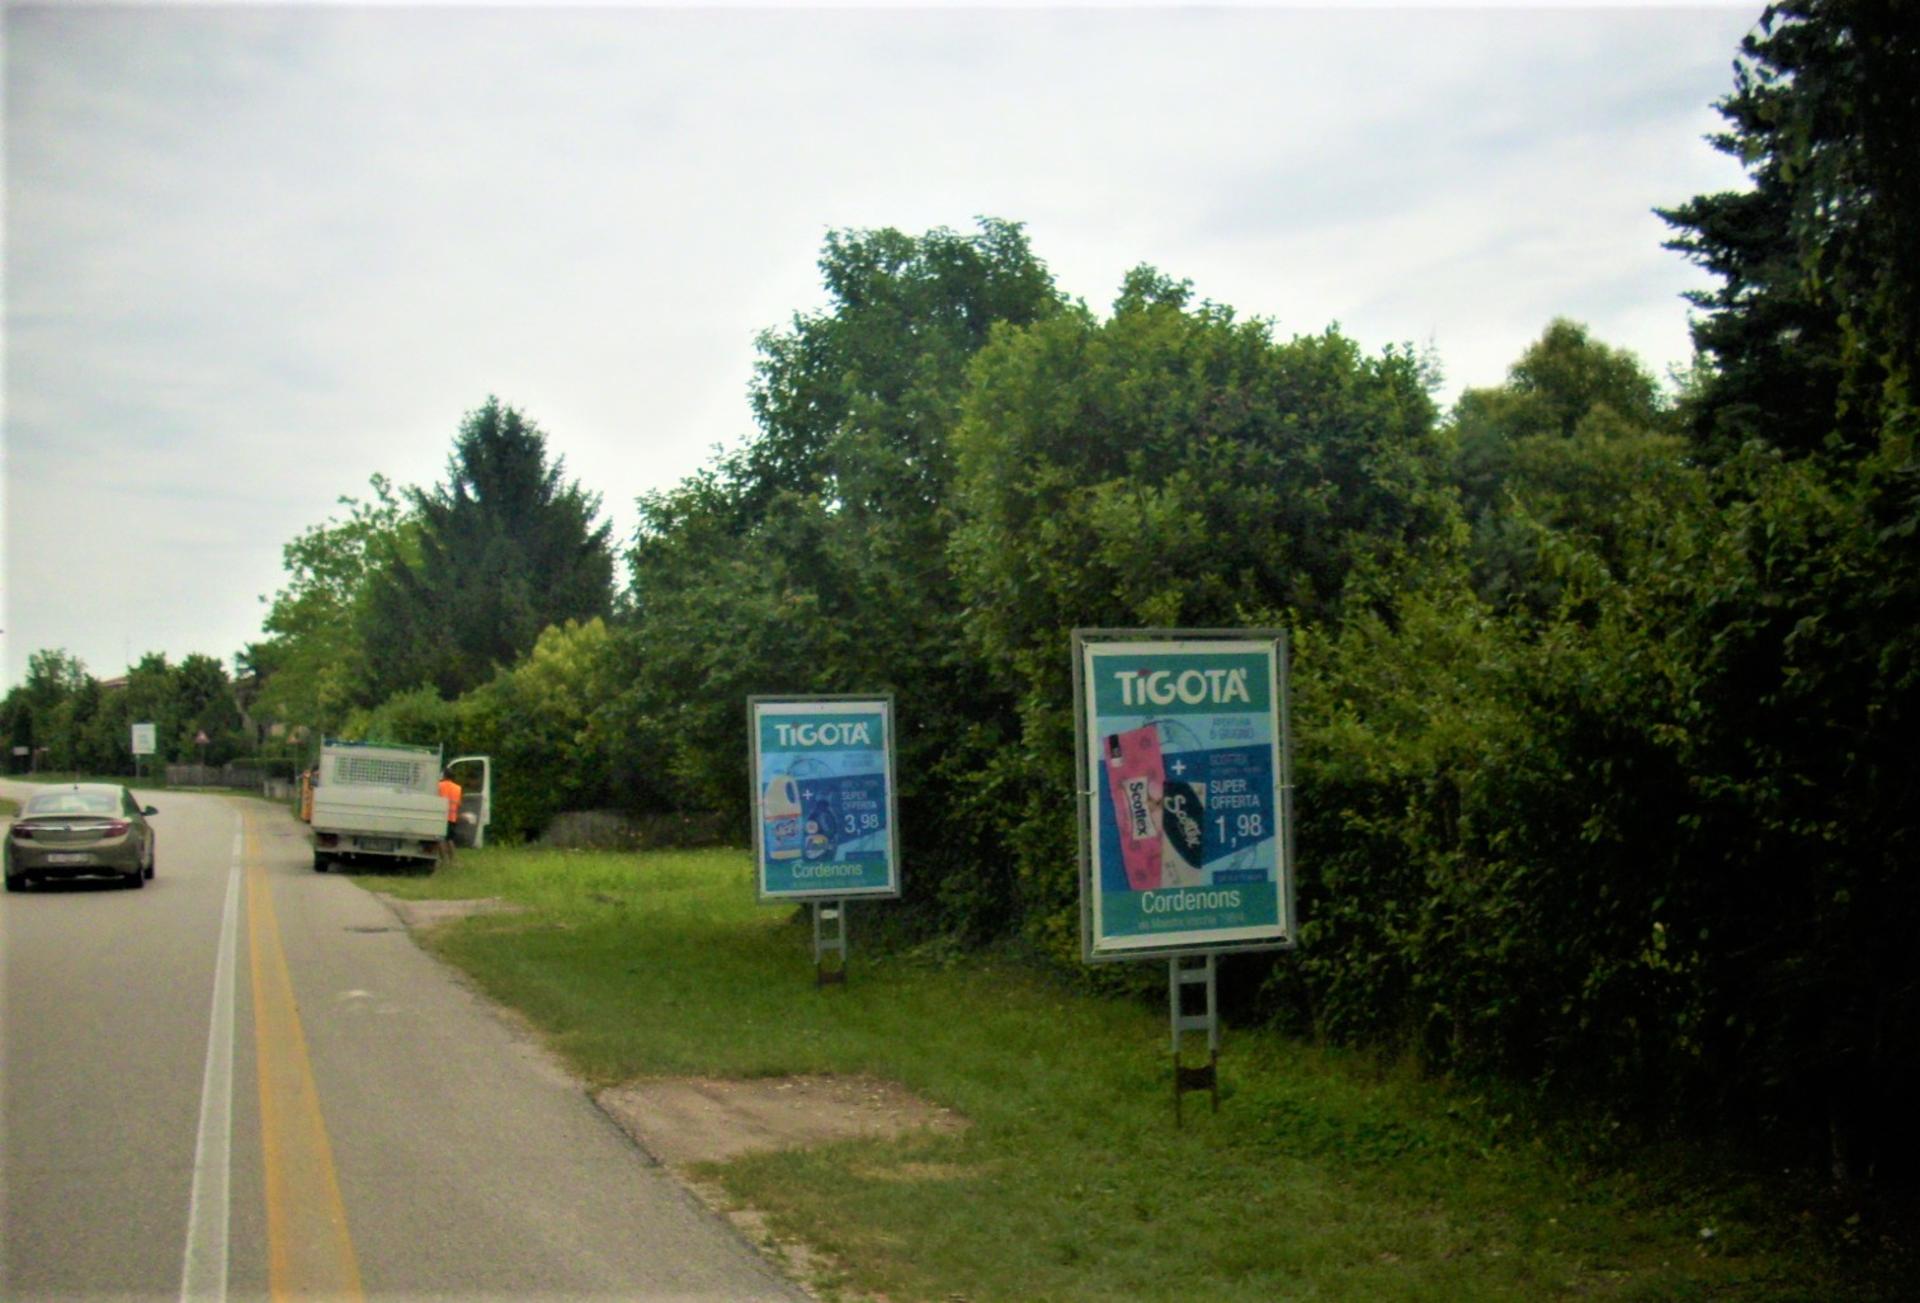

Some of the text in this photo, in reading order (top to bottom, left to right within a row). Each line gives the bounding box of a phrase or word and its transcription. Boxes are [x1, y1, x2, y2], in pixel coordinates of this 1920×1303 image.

[1210, 779, 1247, 794] SUPER
[1211, 794, 1261, 810] OFFERTA
[844, 814, 880, 835] 3,98
[1214, 813, 1262, 848] 1,98
[792, 862, 863, 879] Cordenons
[1141, 889, 1241, 914] Cordenons
